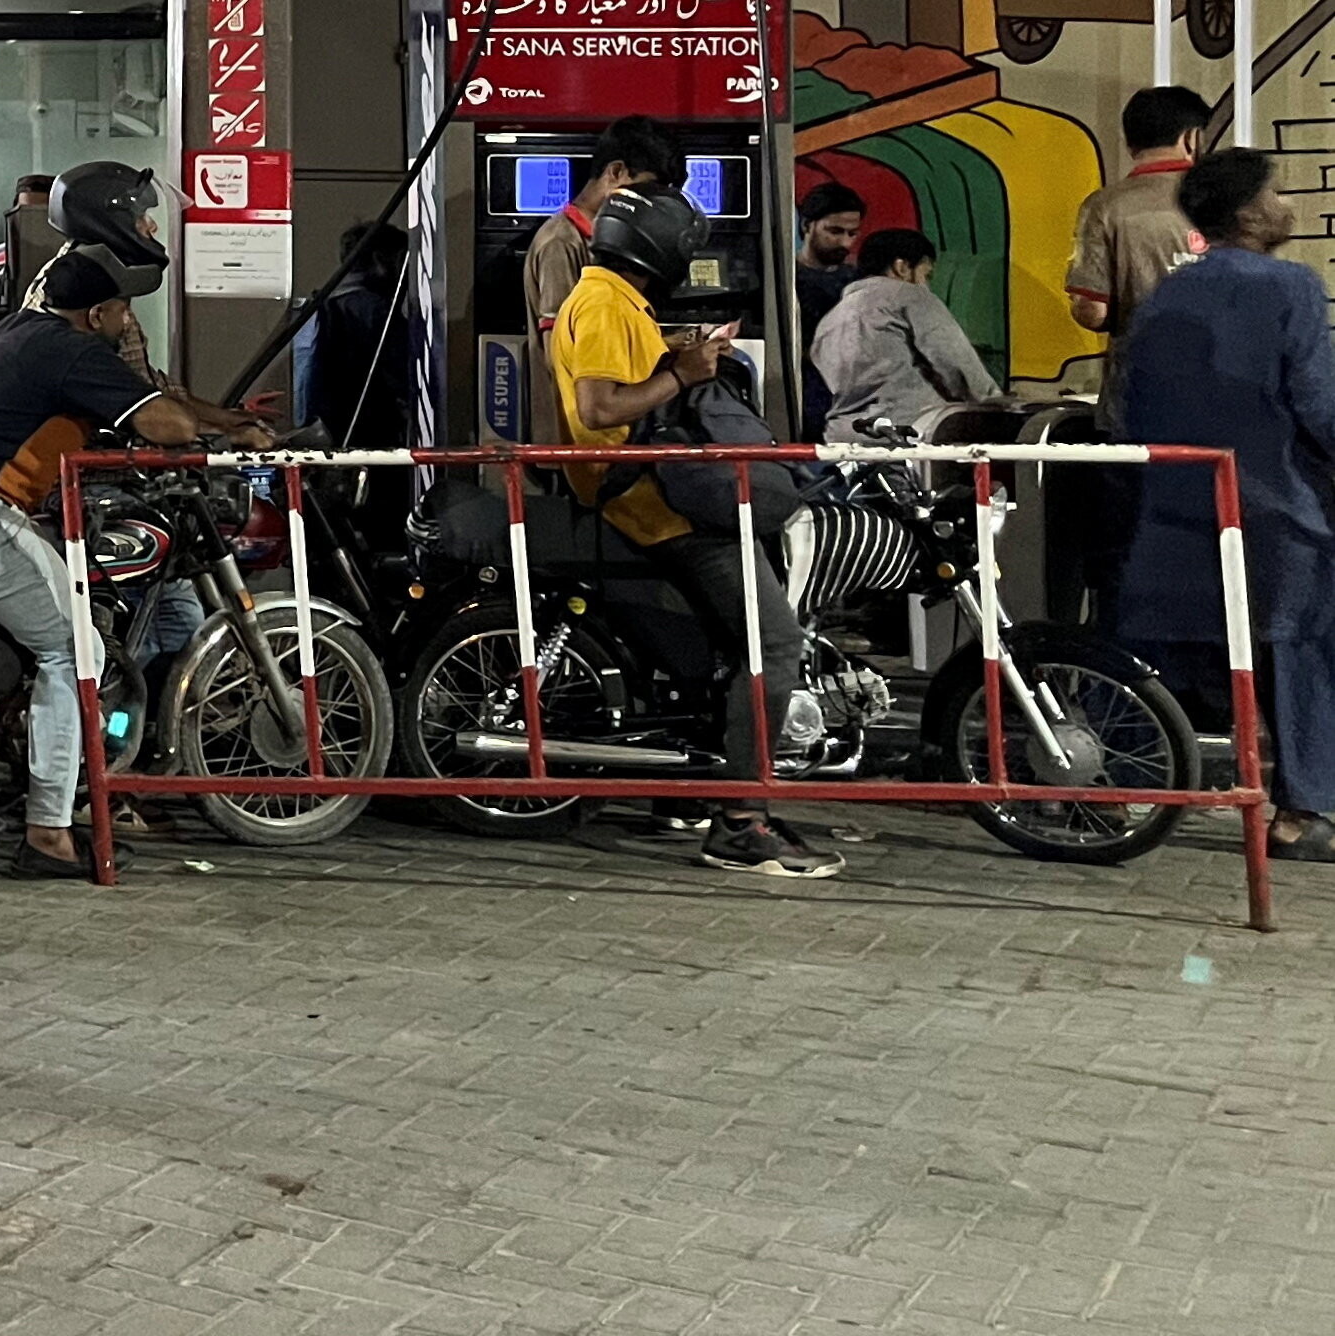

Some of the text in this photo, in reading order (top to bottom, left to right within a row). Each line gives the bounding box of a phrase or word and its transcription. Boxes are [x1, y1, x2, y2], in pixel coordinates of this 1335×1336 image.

[503, 37, 566, 57] SANA
[572, 36, 662, 57] SERVICE
[494, 357, 509, 427] HI SUPER
